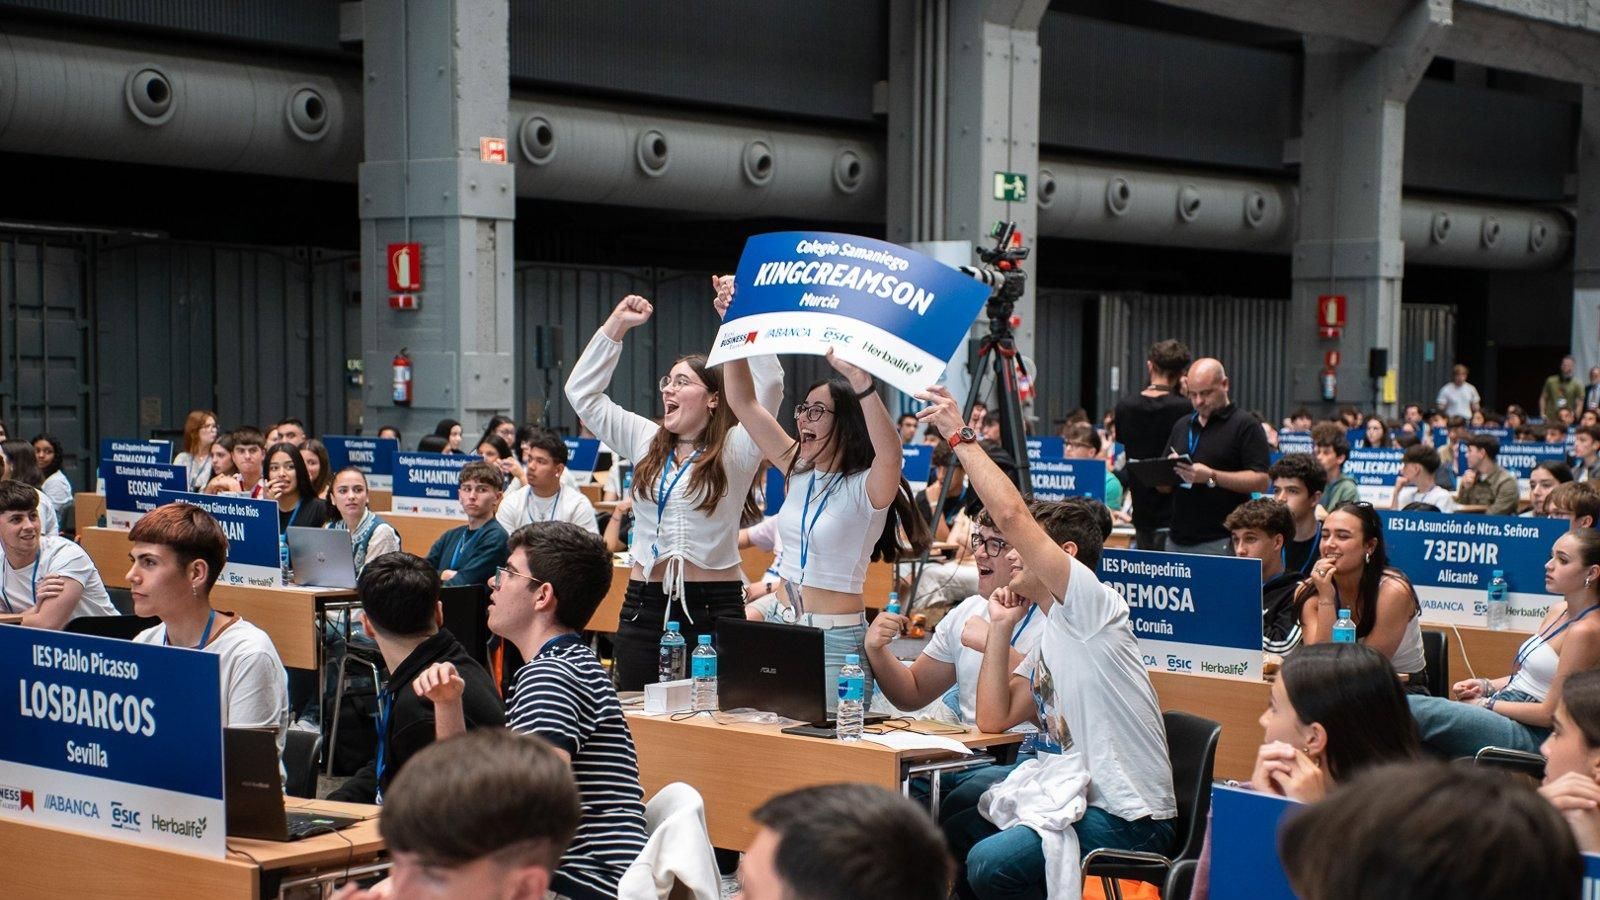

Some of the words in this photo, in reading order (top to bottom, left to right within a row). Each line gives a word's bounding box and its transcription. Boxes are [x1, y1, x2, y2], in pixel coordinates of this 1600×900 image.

[796, 239, 838, 256] Colegio
[839, 242, 910, 271] Samaniego
[753, 260, 934, 316] KINGCREAMSON
[799, 293, 840, 309] Murcia
[720, 334, 747, 348] BUSINESS
[823, 330, 854, 344] esic
[862, 340, 915, 374] Herbalife
[399, 456, 416, 467] Colegio
[212, 502, 228, 514] Giner
[228, 504, 235, 514] de
[236, 504, 245, 516] los
[1388, 518, 1403, 531] IES
[1405, 519, 1416, 531] La
[1417, 519, 1462, 534] Asunción
[1463, 522, 1476, 535] de
[1477, 522, 1501, 536] Ntra.
[1504, 523, 1539, 538] Señora
[1423, 539, 1499, 565] 73EDMR
[1102, 558, 1119, 573] IES
[1120, 559, 1192, 579] Pontepedriña
[1438, 569, 1478, 584] Alicante
[1103, 580, 1195, 613] REMOSA
[1506, 606, 1545, 619] Herbalife
[1136, 618, 1173, 635] Coruña
[32, 644, 52, 668] IES
[54, 648, 89, 673] Pablo
[91, 652, 139, 680] Picasso
[760, 666, 777, 674] ASUS
[1168, 658, 1192, 670] esic
[1201, 662, 1244, 676] Herbalife
[19, 679, 156, 737] LOSBARCOS
[66, 740, 108, 768] Sevilla
[112, 806, 141, 826] esic
[152, 814, 202, 839] Herbalife
